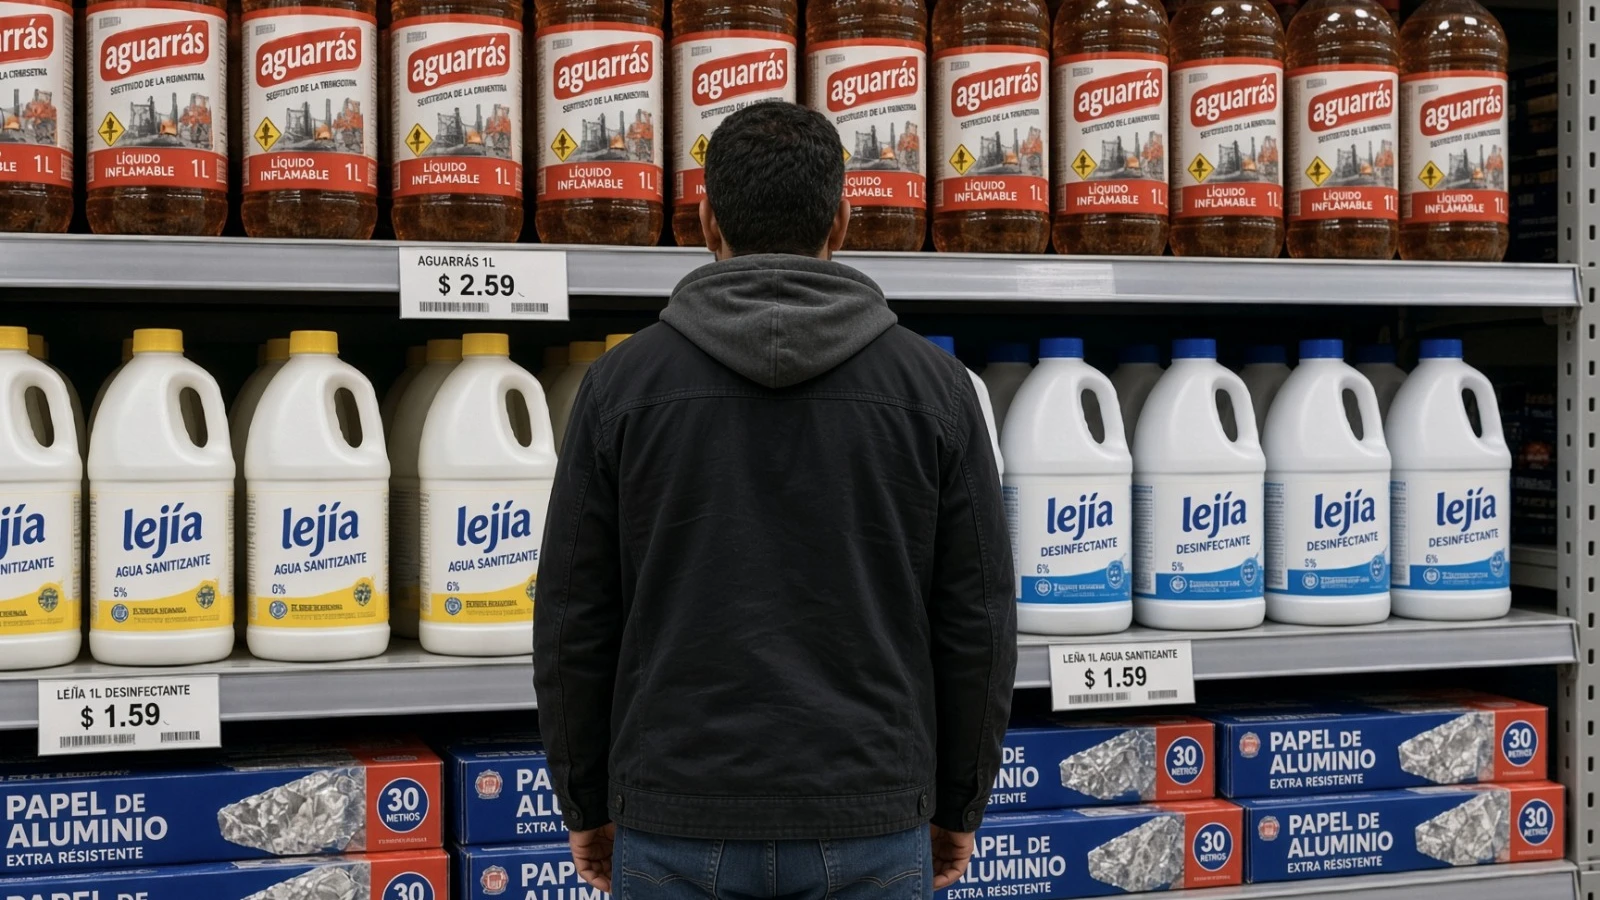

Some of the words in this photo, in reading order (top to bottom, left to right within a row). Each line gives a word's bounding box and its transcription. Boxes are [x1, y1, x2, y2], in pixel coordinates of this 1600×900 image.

[0, 18, 48, 52] rrás
[105, 25, 204, 74] aguarrás
[261, 32, 356, 80] aguarrás
[412, 38, 506, 86] aguarrás
[558, 45, 648, 93] aguarrás
[697, 53, 784, 100] aguarrás
[831, 60, 916, 105] aguarrás
[956, 66, 1038, 111] aguarrás
[1078, 72, 1159, 116] aguarrás
[1195, 77, 1275, 121] aguarrás
[1313, 84, 1390, 126] aguarrás
[1425, 89, 1500, 131] aguarrás
[105, 166, 174, 178] INFLAMABLE
[260, 170, 328, 180] INFLAMABLE
[412, 174, 480, 184] INFLAMABLE
[558, 179, 623, 190] INFLAMABLE
[955, 192, 1017, 202] INFLAMABLE
[1077, 195, 1138, 206] INFLAMABLE
[1195, 198, 1256, 208] INFLAMABLE
[1312, 201, 1372, 212] INFLAMABLE
[1425, 203, 1484, 214] INFLAMABLE
[418, 254, 478, 266] AGUARRÁS
[482, 258, 495, 268] 1L
[438, 274, 450, 296] $
[460, 274, 514, 296] 2.59
[1047, 492, 1113, 540] lejía
[1182, 491, 1246, 538] lejía
[1314, 489, 1375, 536] lejía
[1437, 487, 1496, 532] lejía
[123, 502, 202, 558] lejía
[282, 502, 359, 557] lejía
[457, 500, 531, 553] lejía
[1041, 538, 1117, 557] DESINFECTANTE
[1176, 536, 1250, 554] DESINFECTANTE
[1307, 532, 1378, 551] DESINFECTANTE
[1429, 529, 1498, 548] DESINFECTANTE
[116, 564, 143, 578] AGUA
[146, 554, 210, 574] SANITIZANTE
[274, 563, 301, 575] AGUA
[304, 552, 367, 572] SANITIZANTE
[448, 560, 474, 572] AGUA
[478, 549, 538, 569] SANITIZANTE
[1037, 564, 1050, 574] 6%
[1172, 562, 1184, 572] 5%
[1426, 554, 1438, 564] 6%
[114, 587, 127, 598] 5%
[447, 581, 459, 592] 6%
[1088, 653, 1098, 662] 1L
[1100, 652, 1123, 662] AGUA
[1085, 668, 1095, 689] $
[1104, 666, 1146, 688] 1.59
[90, 688, 101, 699] 1L
[105, 684, 190, 698] DESINFECTANTE
[81, 706, 94, 730] $
[104, 702, 160, 728] 1.59
[1270, 729, 1334, 752] PAPEL
[1340, 731, 1361, 747] DE
[1509, 728, 1531, 748] 30
[1003, 747, 1024, 764] DE
[1173, 746, 1197, 766] 30
[1270, 749, 1376, 774] ALUMINIO
[1270, 778, 1302, 789] EXTRA
[7, 792, 106, 820] PAPEL
[116, 794, 145, 814] DE
[387, 788, 419, 812] 30
[1289, 811, 1353, 835] PAPEL
[1358, 812, 1379, 829] DE
[1525, 807, 1547, 827] 30
[6, 816, 168, 848] ALUMINIO
[516, 822, 557, 834] EXTRA
[1028, 836, 1050, 854] DE
[1201, 831, 1225, 852] 30
[1288, 831, 1393, 858] ALUMINIO
[7, 854, 54, 866] EXTRA
[1288, 862, 1320, 873] EXTRA
[948, 888, 983, 900] EXTRA
